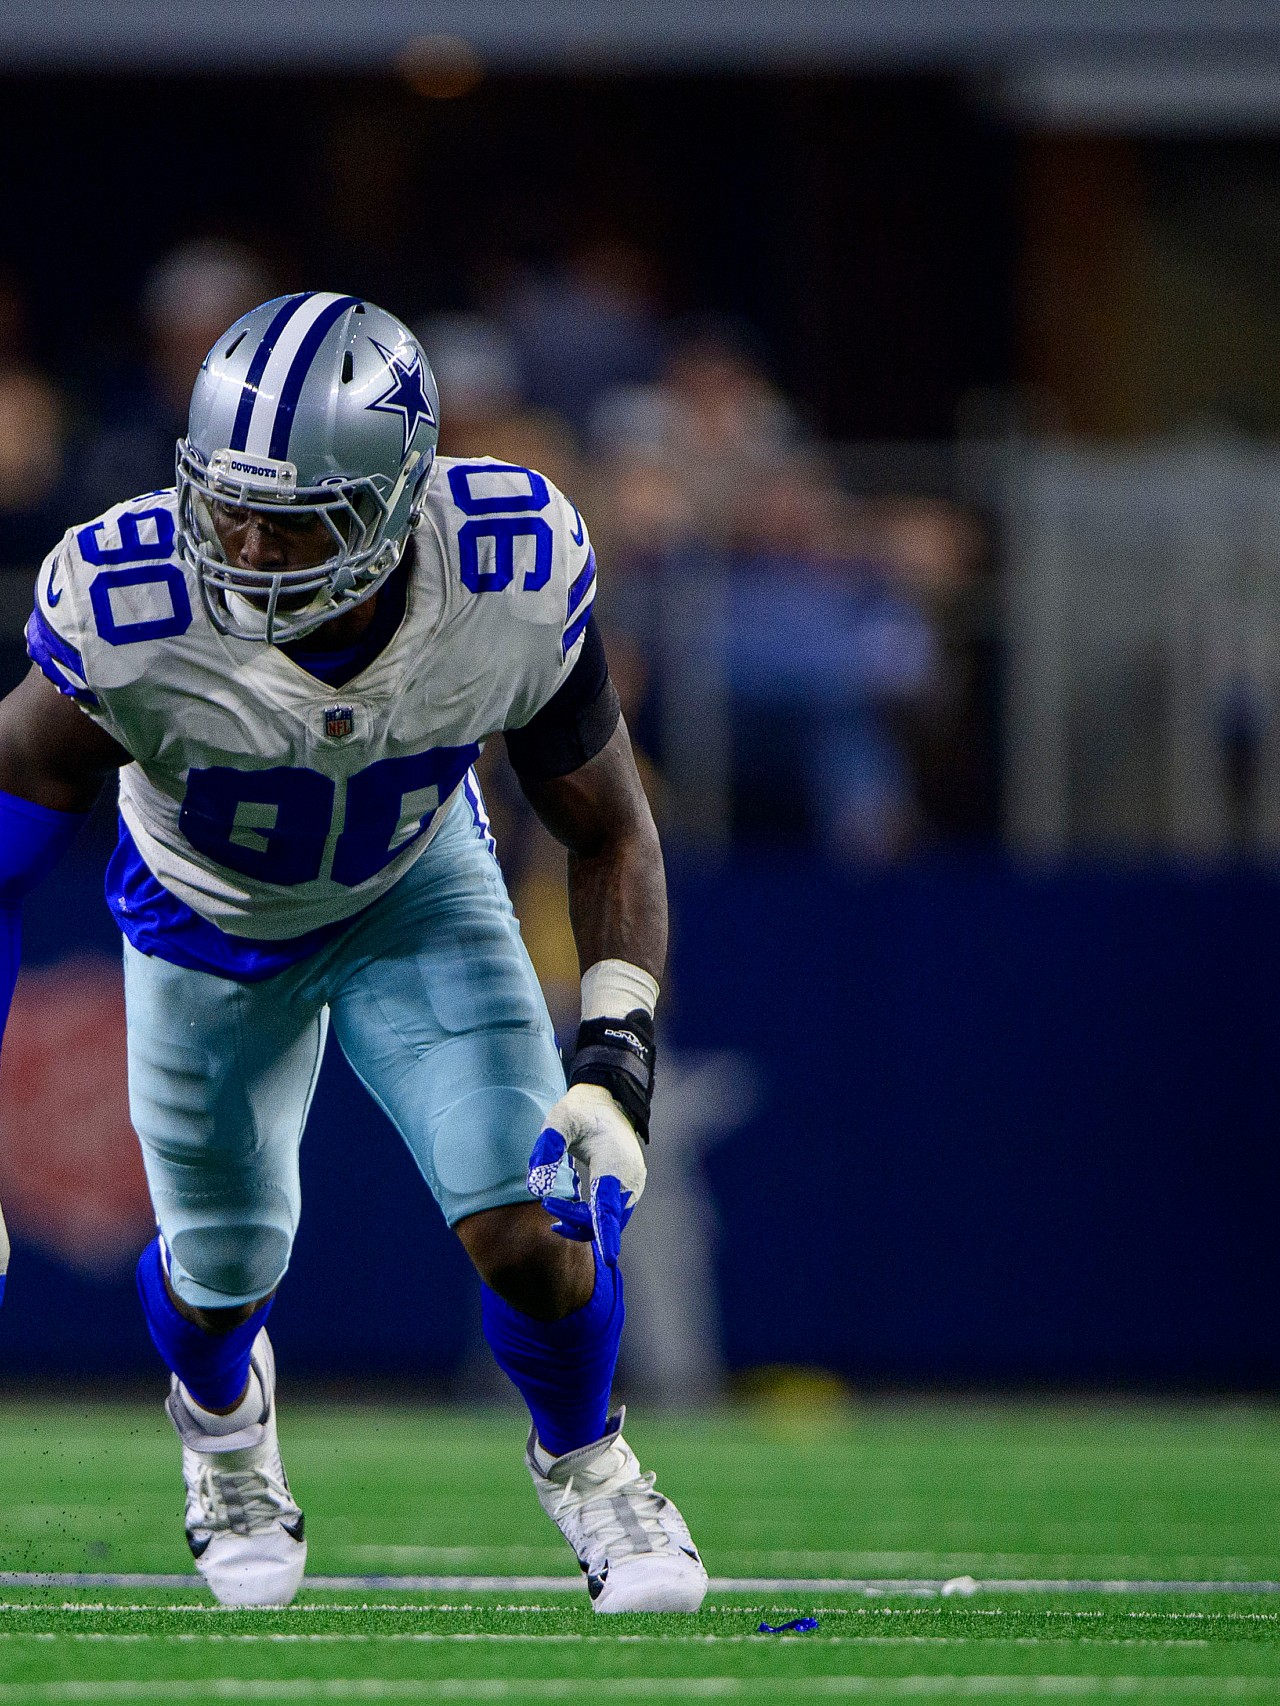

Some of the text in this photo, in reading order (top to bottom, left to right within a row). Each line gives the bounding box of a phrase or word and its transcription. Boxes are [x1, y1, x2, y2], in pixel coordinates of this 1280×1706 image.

[231, 460, 277, 478] COWBOYS
[446, 463, 553, 594] 90
[77, 507, 192, 647] 90
